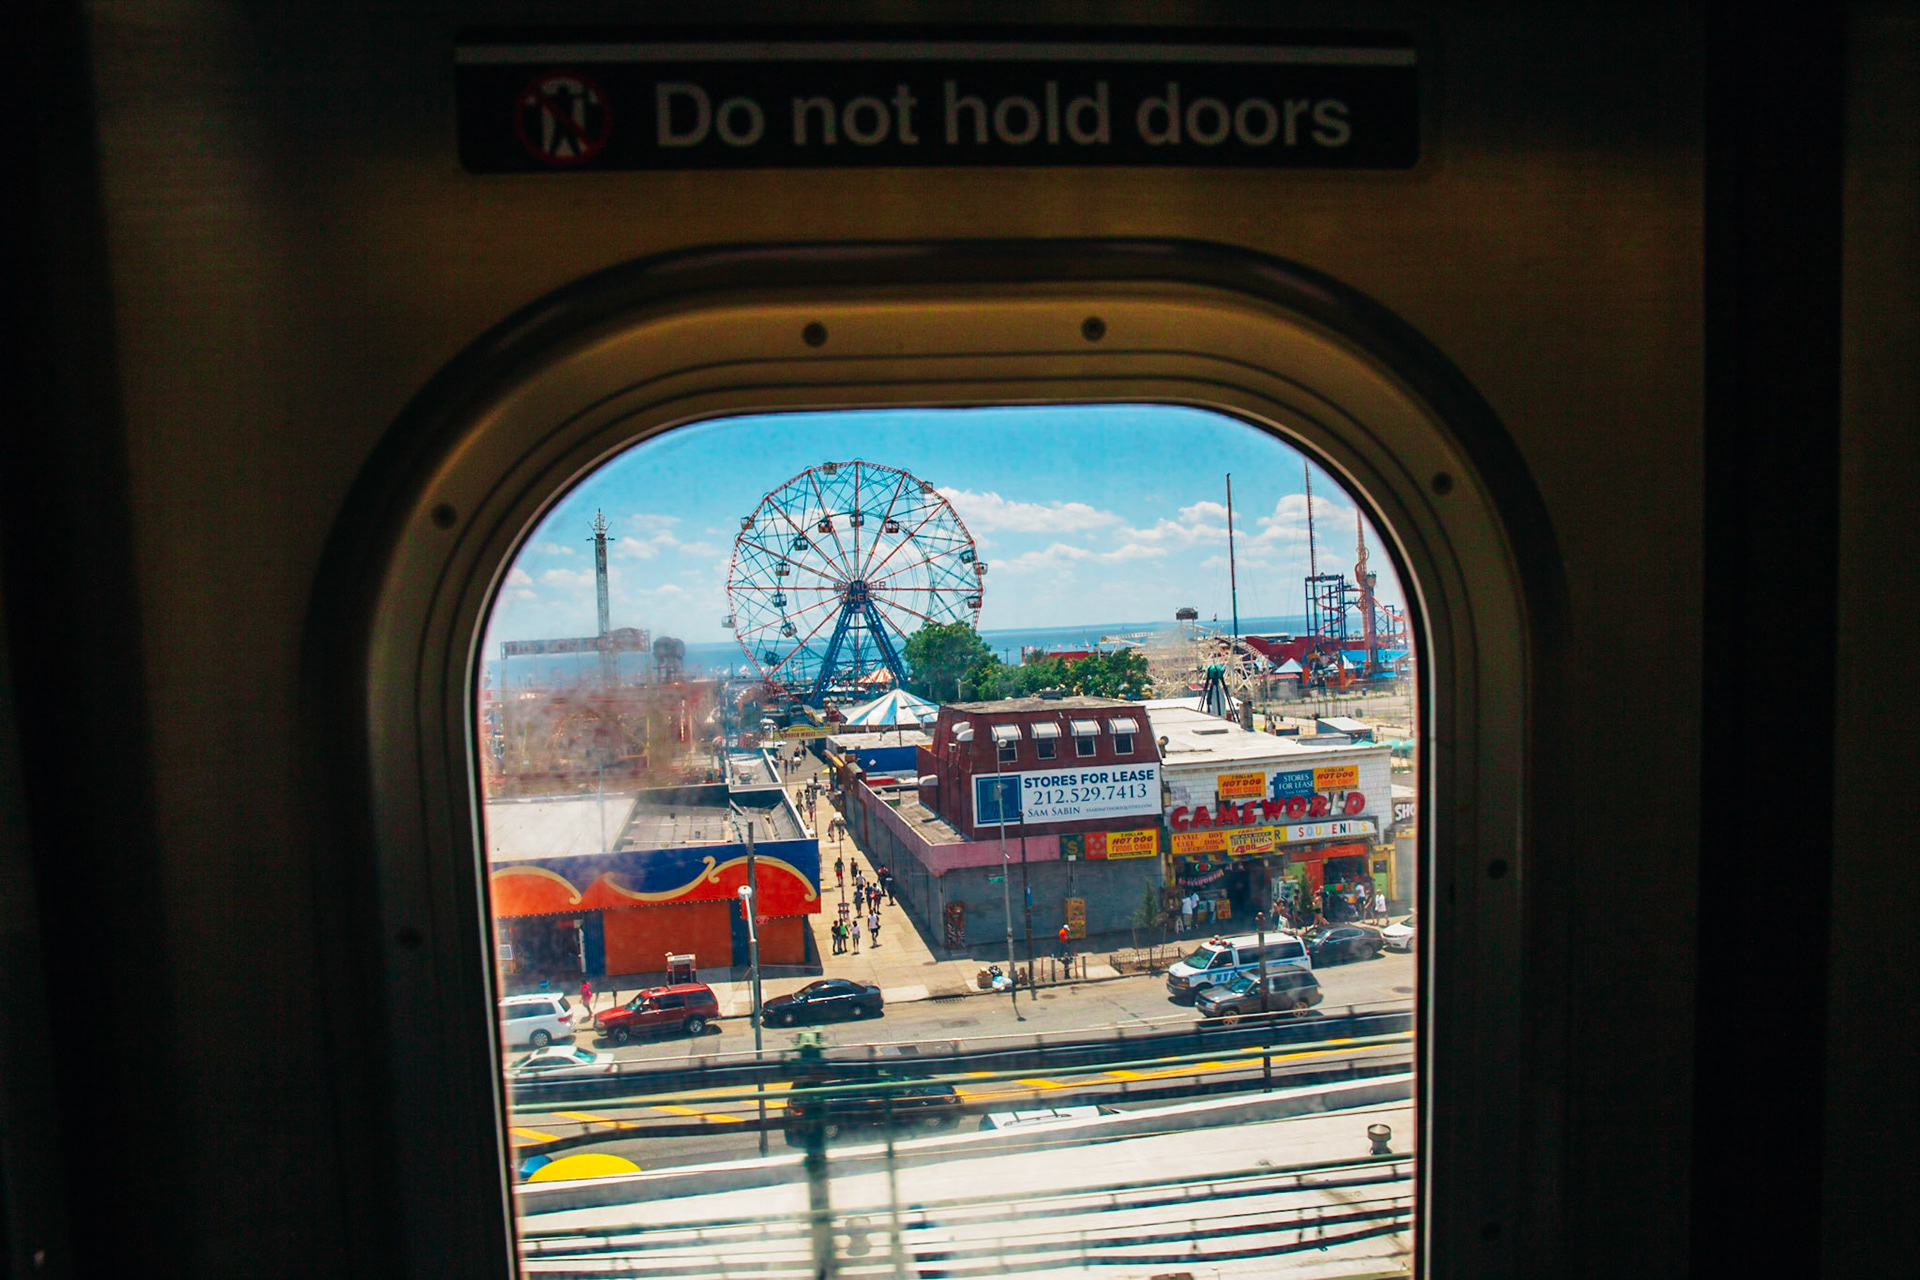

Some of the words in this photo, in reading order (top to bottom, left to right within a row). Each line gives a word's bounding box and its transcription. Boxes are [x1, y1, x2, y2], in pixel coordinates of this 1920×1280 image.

[655, 80, 765, 147] Do
[791, 82, 920, 147] not
[942, 79, 1111, 147] hold
[1135, 80, 1352, 148] doors
[1024, 774, 1078, 789] STORES
[1081, 772, 1108, 786] FOR
[1112, 769, 1155, 783] LEASE
[1283, 773, 1310, 783] STORES
[1336, 771, 1354, 779] DOG
[1242, 778, 1262, 786] DOG
[1278, 782, 1294, 790] FOR
[1033, 783, 1147, 806] 212.529.7413
[1027, 808, 1049, 818] SAM
[1051, 806, 1081, 817] SABIN
[1298, 820, 1368, 838] SOUENIS
[1112, 837, 1131, 845] HOT
[1133, 835, 1153, 843] DOG
[1250, 836, 1272, 844] DOGS
